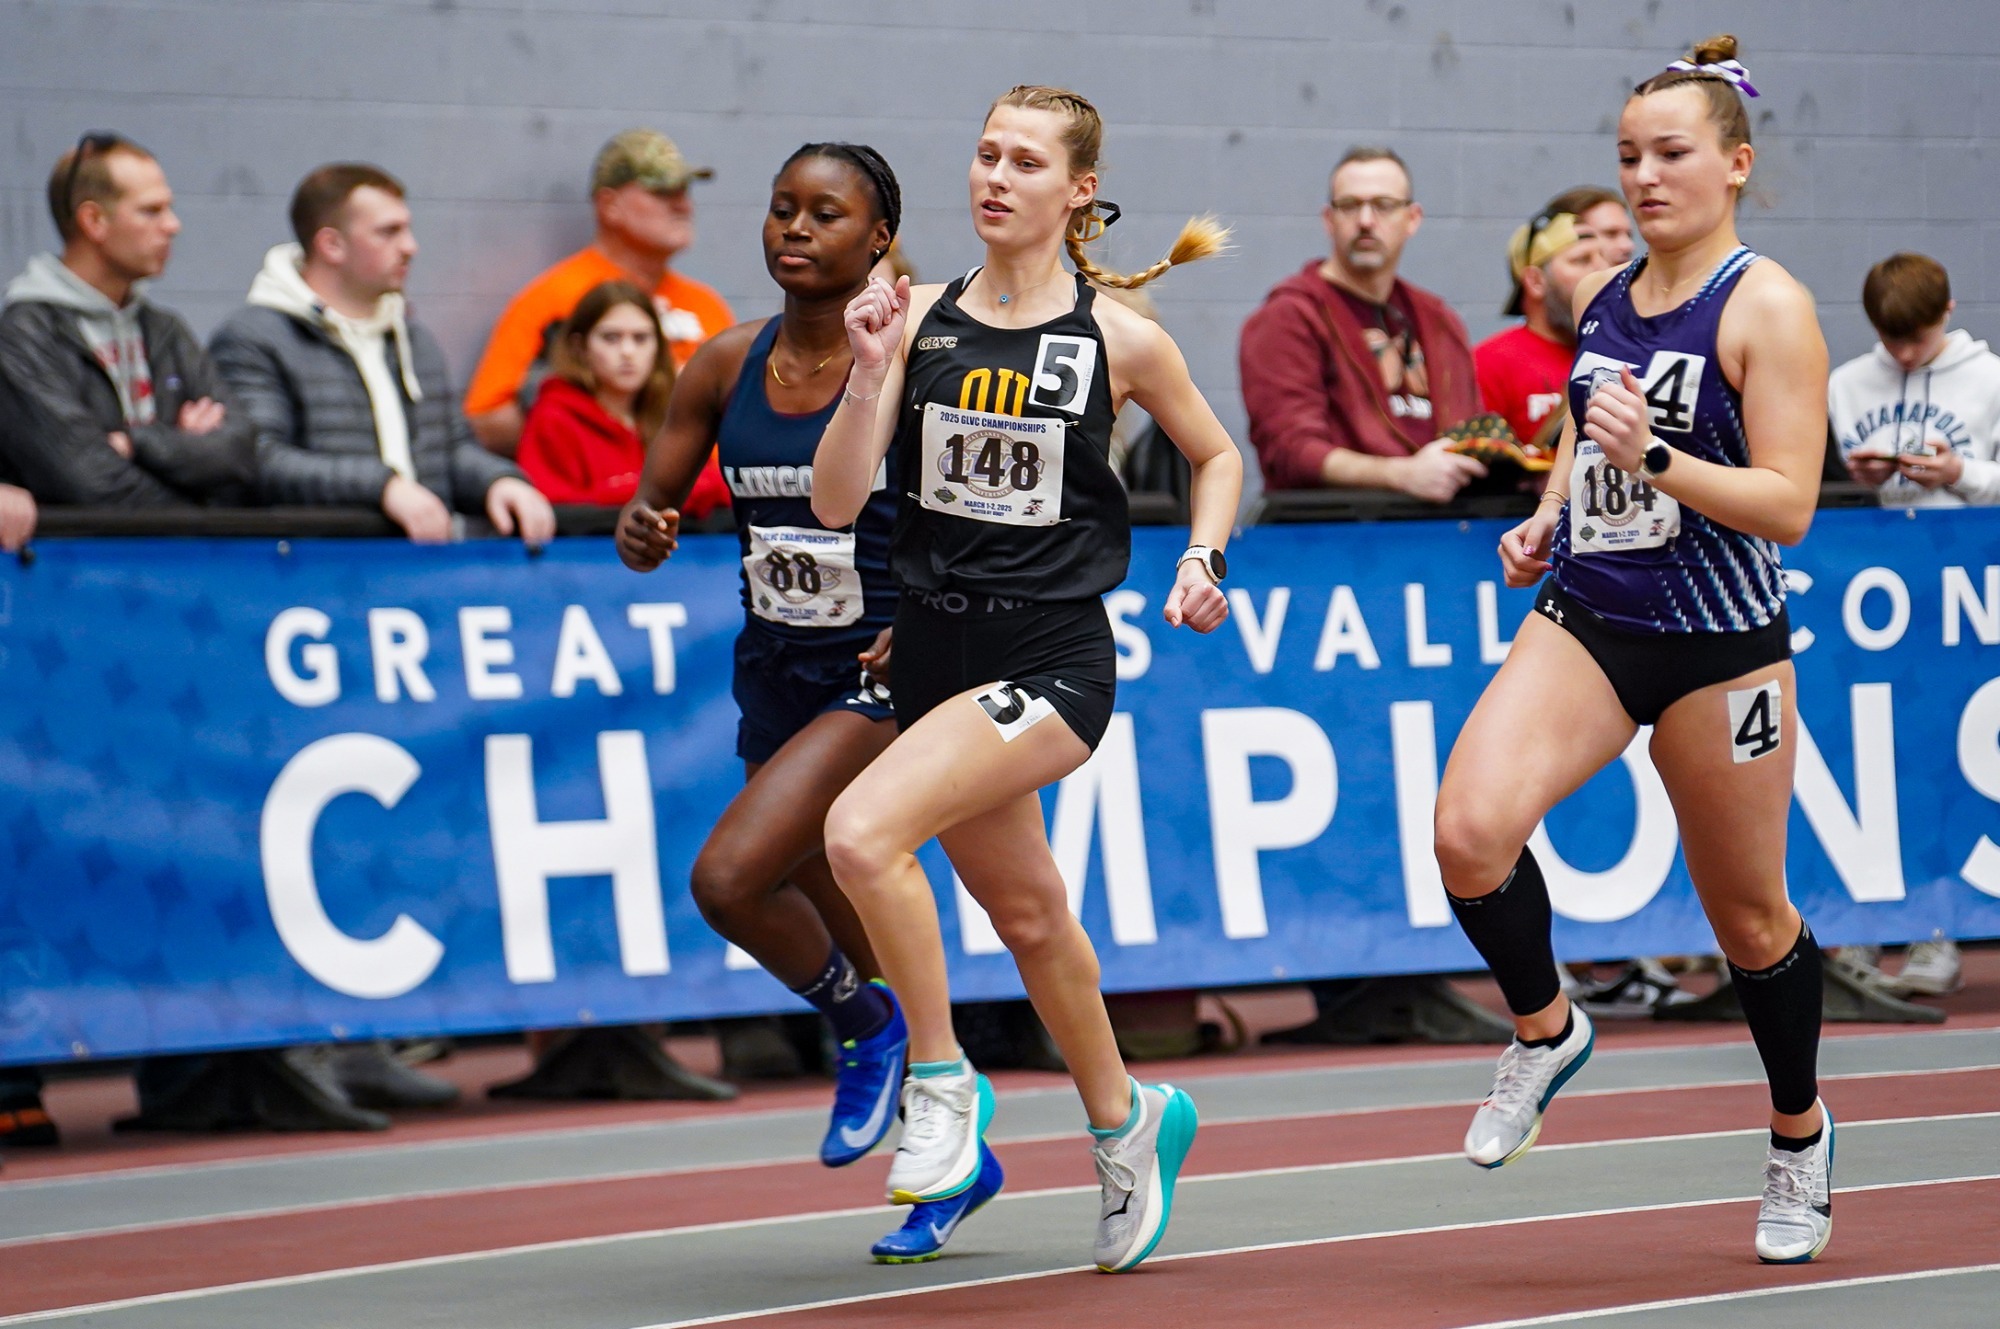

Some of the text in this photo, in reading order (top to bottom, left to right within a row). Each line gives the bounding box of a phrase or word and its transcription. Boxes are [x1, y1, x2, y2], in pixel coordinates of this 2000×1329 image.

[917, 336, 958, 350] GLVC
[1034, 342, 1080, 407] 5
[1644, 358, 1690, 430] 4
[940, 412, 1046, 433] 2025 GLVC CHAMPIONSHIPS
[1843, 402, 1974, 458] NDIANAPOLI
[944, 433, 1040, 491] 148
[1585, 463, 1658, 517] 184
[766, 551, 820, 594] 88
[265, 602, 688, 707] GREAT
[1227, 580, 1512, 674] VALL
[1735, 689, 1780, 758] 4
[260, 675, 2000, 1000] CHMPION
